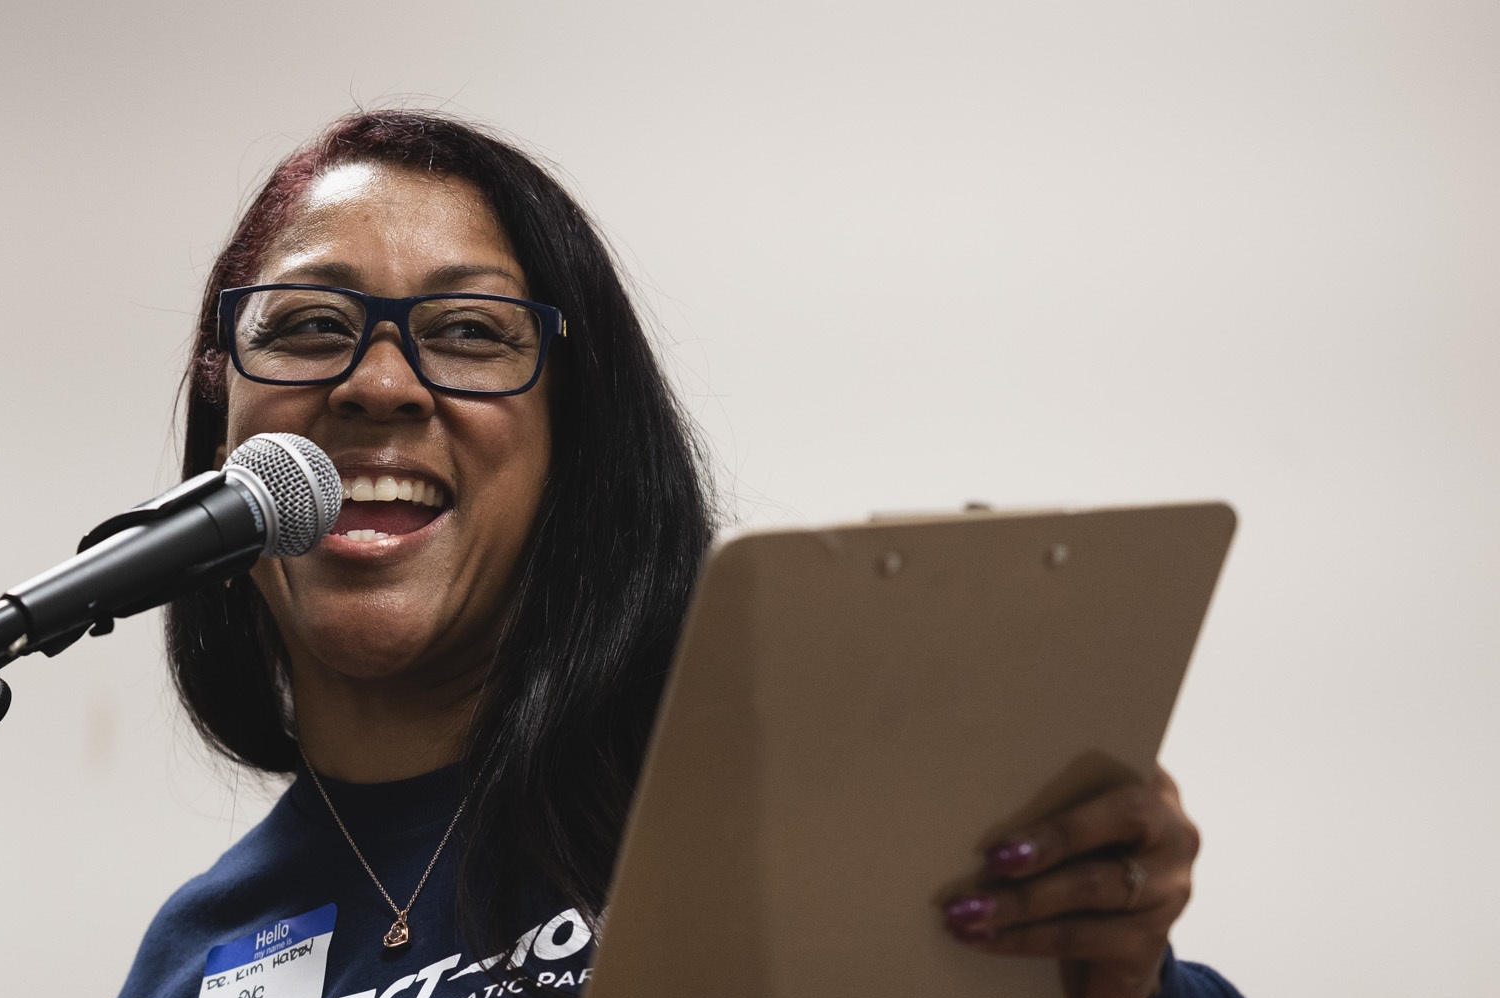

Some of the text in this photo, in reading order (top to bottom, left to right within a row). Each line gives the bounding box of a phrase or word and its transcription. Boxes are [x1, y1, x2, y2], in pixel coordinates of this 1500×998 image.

[253, 937, 293, 961] my name is
[255, 922, 290, 950] Hello
